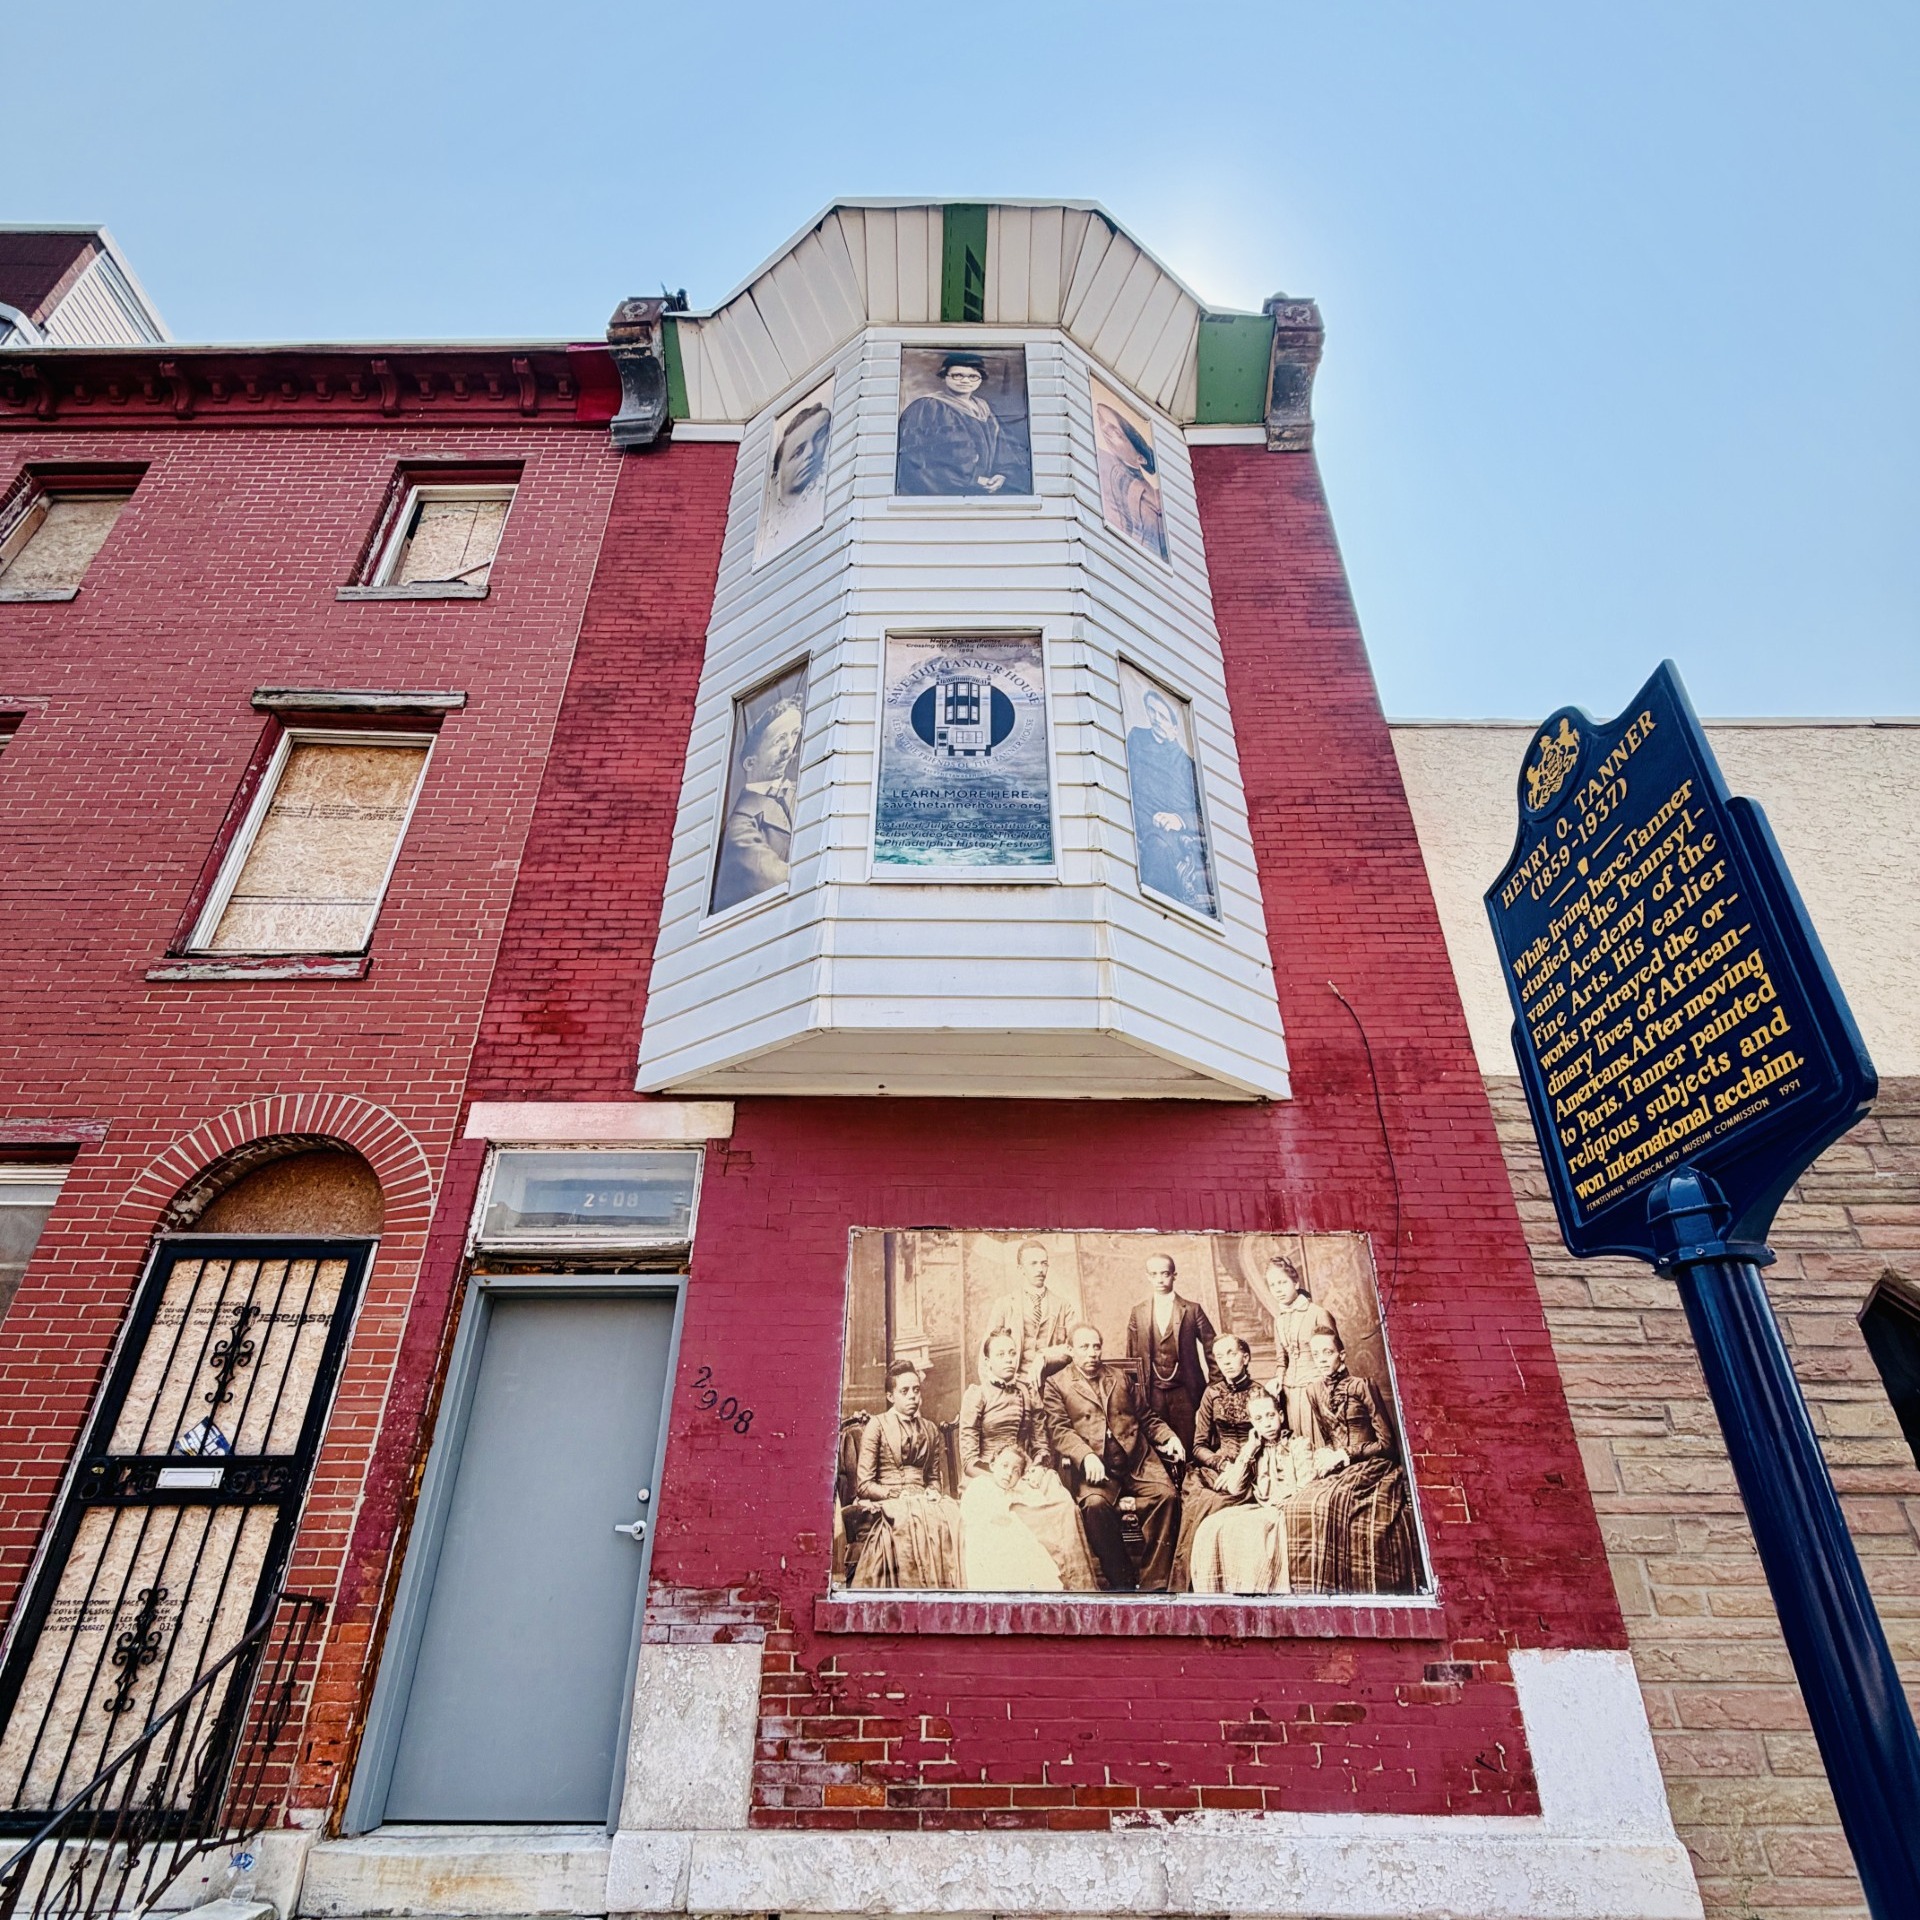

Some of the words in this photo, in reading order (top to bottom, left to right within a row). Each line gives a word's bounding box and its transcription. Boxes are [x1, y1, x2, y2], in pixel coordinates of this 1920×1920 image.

[888, 678, 912, 705] SAVE
[909, 663, 939, 681] THE
[941, 658, 1003, 675] TANNER
[1004, 671, 1040, 705] HOUSE
[1019, 718, 1035, 743] HOUSE
[877, 821, 923, 829] nstalled
[924, 821, 948, 831] July
[883, 839, 953, 849] Philadelphia
[956, 840, 998, 849] History
[893, 790, 940, 798] LEARN
[944, 790, 987, 799] MORE
[911, 830, 943, 838] Video
[1500, 840, 1550, 909] HENRY
[1555, 816, 1573, 840] O.
[1573, 710, 1656, 815] TANNER
[1512, 936, 1551, 979] While
[1547, 892, 1592, 944] living
[1623, 779, 1693, 863] Tanner
[1520, 938, 1572, 1003] studied
[1571, 922, 1590, 949] at
[1587, 896, 1619, 931] the
[1616, 807, 1704, 901] Pennsyl-
[1526, 981, 1567, 1024] vania
[1569, 899, 1646, 986] Academy
[1651, 863, 1675, 903] of
[1676, 832, 1717, 875] the
[1531, 1010, 1567, 1050] Fine
[1570, 970, 1614, 1016] Arts.
[1610, 936, 1646, 974] His
[1650, 858, 1726, 938] earlier
[1538, 1028, 1580, 1071] works
[1578, 946, 1666, 1043] portrayed
[1662, 924, 1700, 962] the
[1700, 892, 1740, 930] or-
[1546, 1047, 1594, 1098] dinary
[1592, 1015, 1635, 1057] lives
[1635, 986, 1665, 1023] of
[1652, 922, 1752, 1007] African-
[1630, 1008, 1685, 1066] After
[1682, 948, 1765, 1022] moving
[1559, 1126, 1578, 1148] to
[1575, 1093, 1624, 1136] Paris,
[1616, 1043, 1688, 1103] Tanner
[1688, 971, 1778, 1060] painted
[1567, 1113, 1641, 1176] religious
[1644, 1051, 1732, 1123] subjects
[1738, 1004, 1792, 1059] and
[1574, 1171, 1608, 1201] won
[1604, 1093, 1714, 1183] international
[1712, 1049, 1805, 1115] acclaim.
[1586, 1184, 1625, 1212] PENNSYLVANIA
[1626, 1160, 1664, 1187] HISTORICAL
[1664, 1150, 1680, 1165] AND
[1681, 1130, 1712, 1154] MUSEUM
[1714, 1097, 1770, 1135] COMMISSION
[1778, 1078, 1801, 1096] 1991
[690, 1366, 754, 1434] 2908
